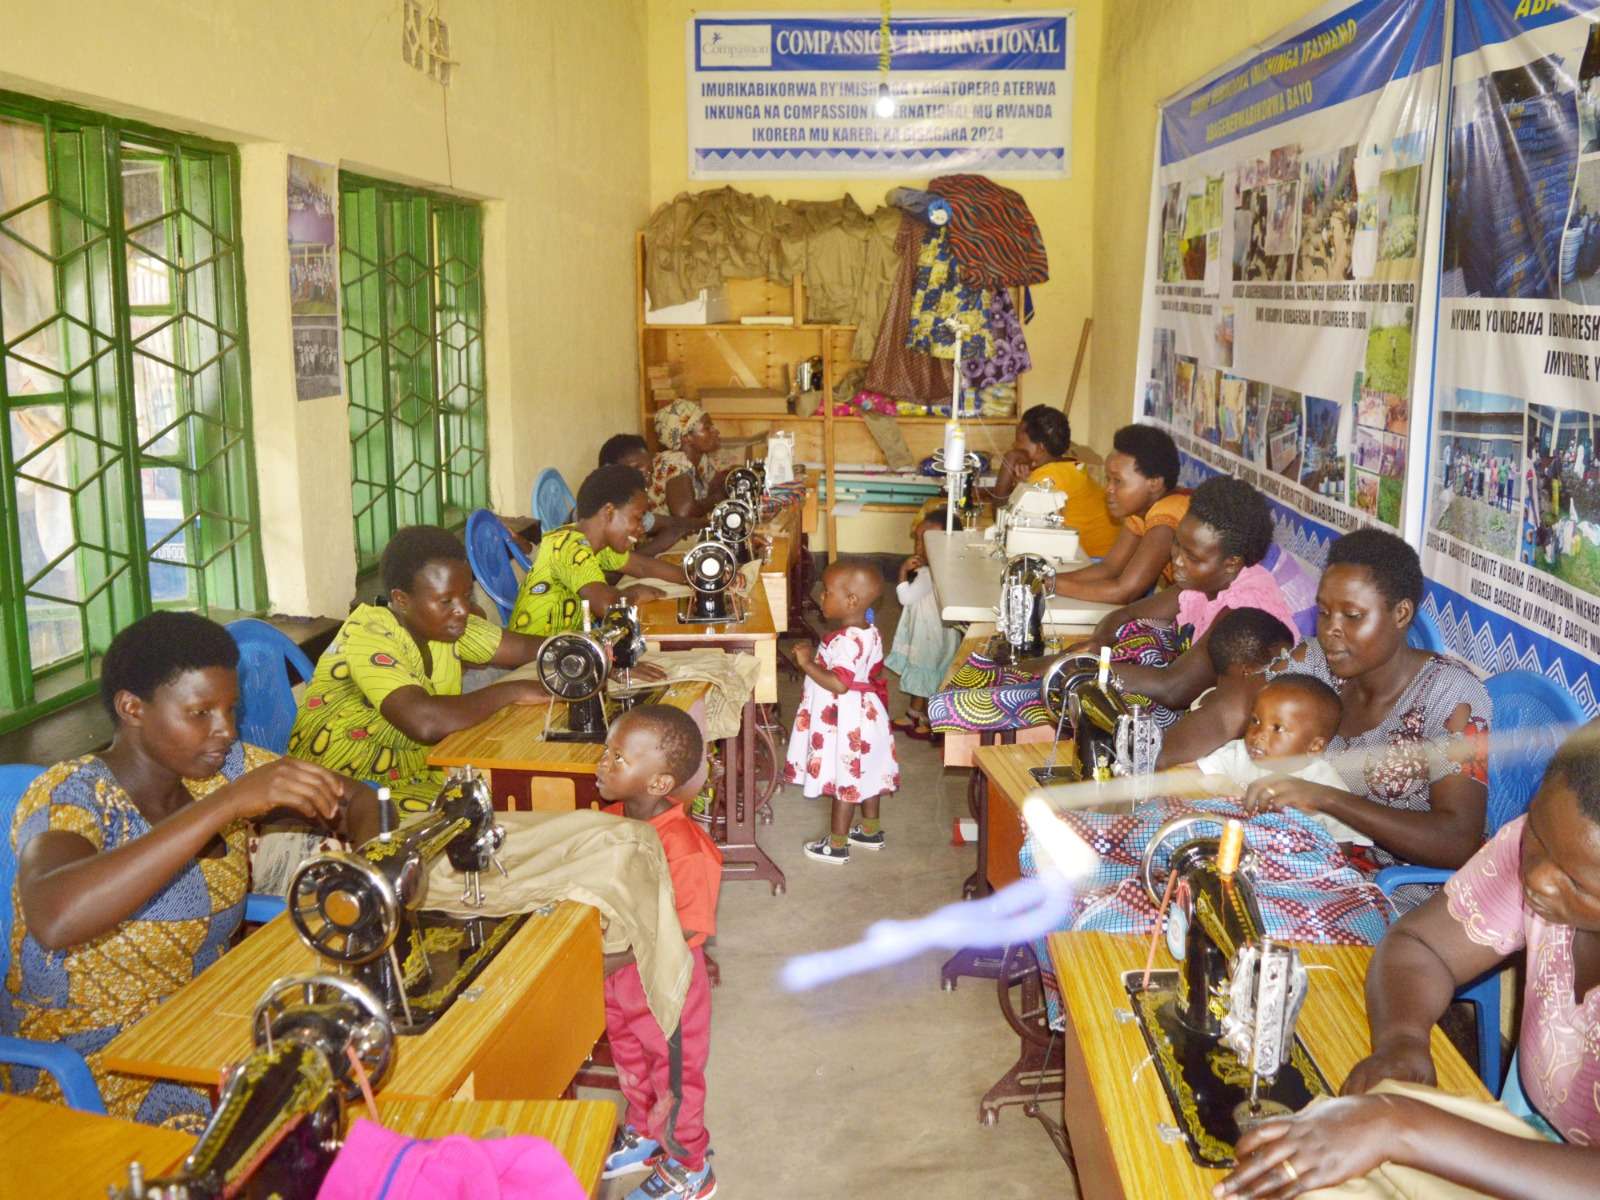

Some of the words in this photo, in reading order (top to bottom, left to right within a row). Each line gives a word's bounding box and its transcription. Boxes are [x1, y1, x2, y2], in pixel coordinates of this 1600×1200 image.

[776, 29, 898, 55] COMPASSION
[907, 28, 1060, 55] INTERNATIONAL
[702, 82, 817, 97] IMURIKABIKORWA
[1003, 81, 1057, 96] ATERWA
[705, 105, 761, 120] INKUNGA
[764, 105, 780, 119] NA
[784, 104, 868, 120] COMPASSION
[973, 104, 992, 119] MU
[996, 104, 1053, 119] RWANDA
[752, 127, 806, 142] IKORERA
[809, 127, 829, 142] MU
[1451, 309, 1481, 332] NYUMA
[1556, 616, 1563, 636] 3
